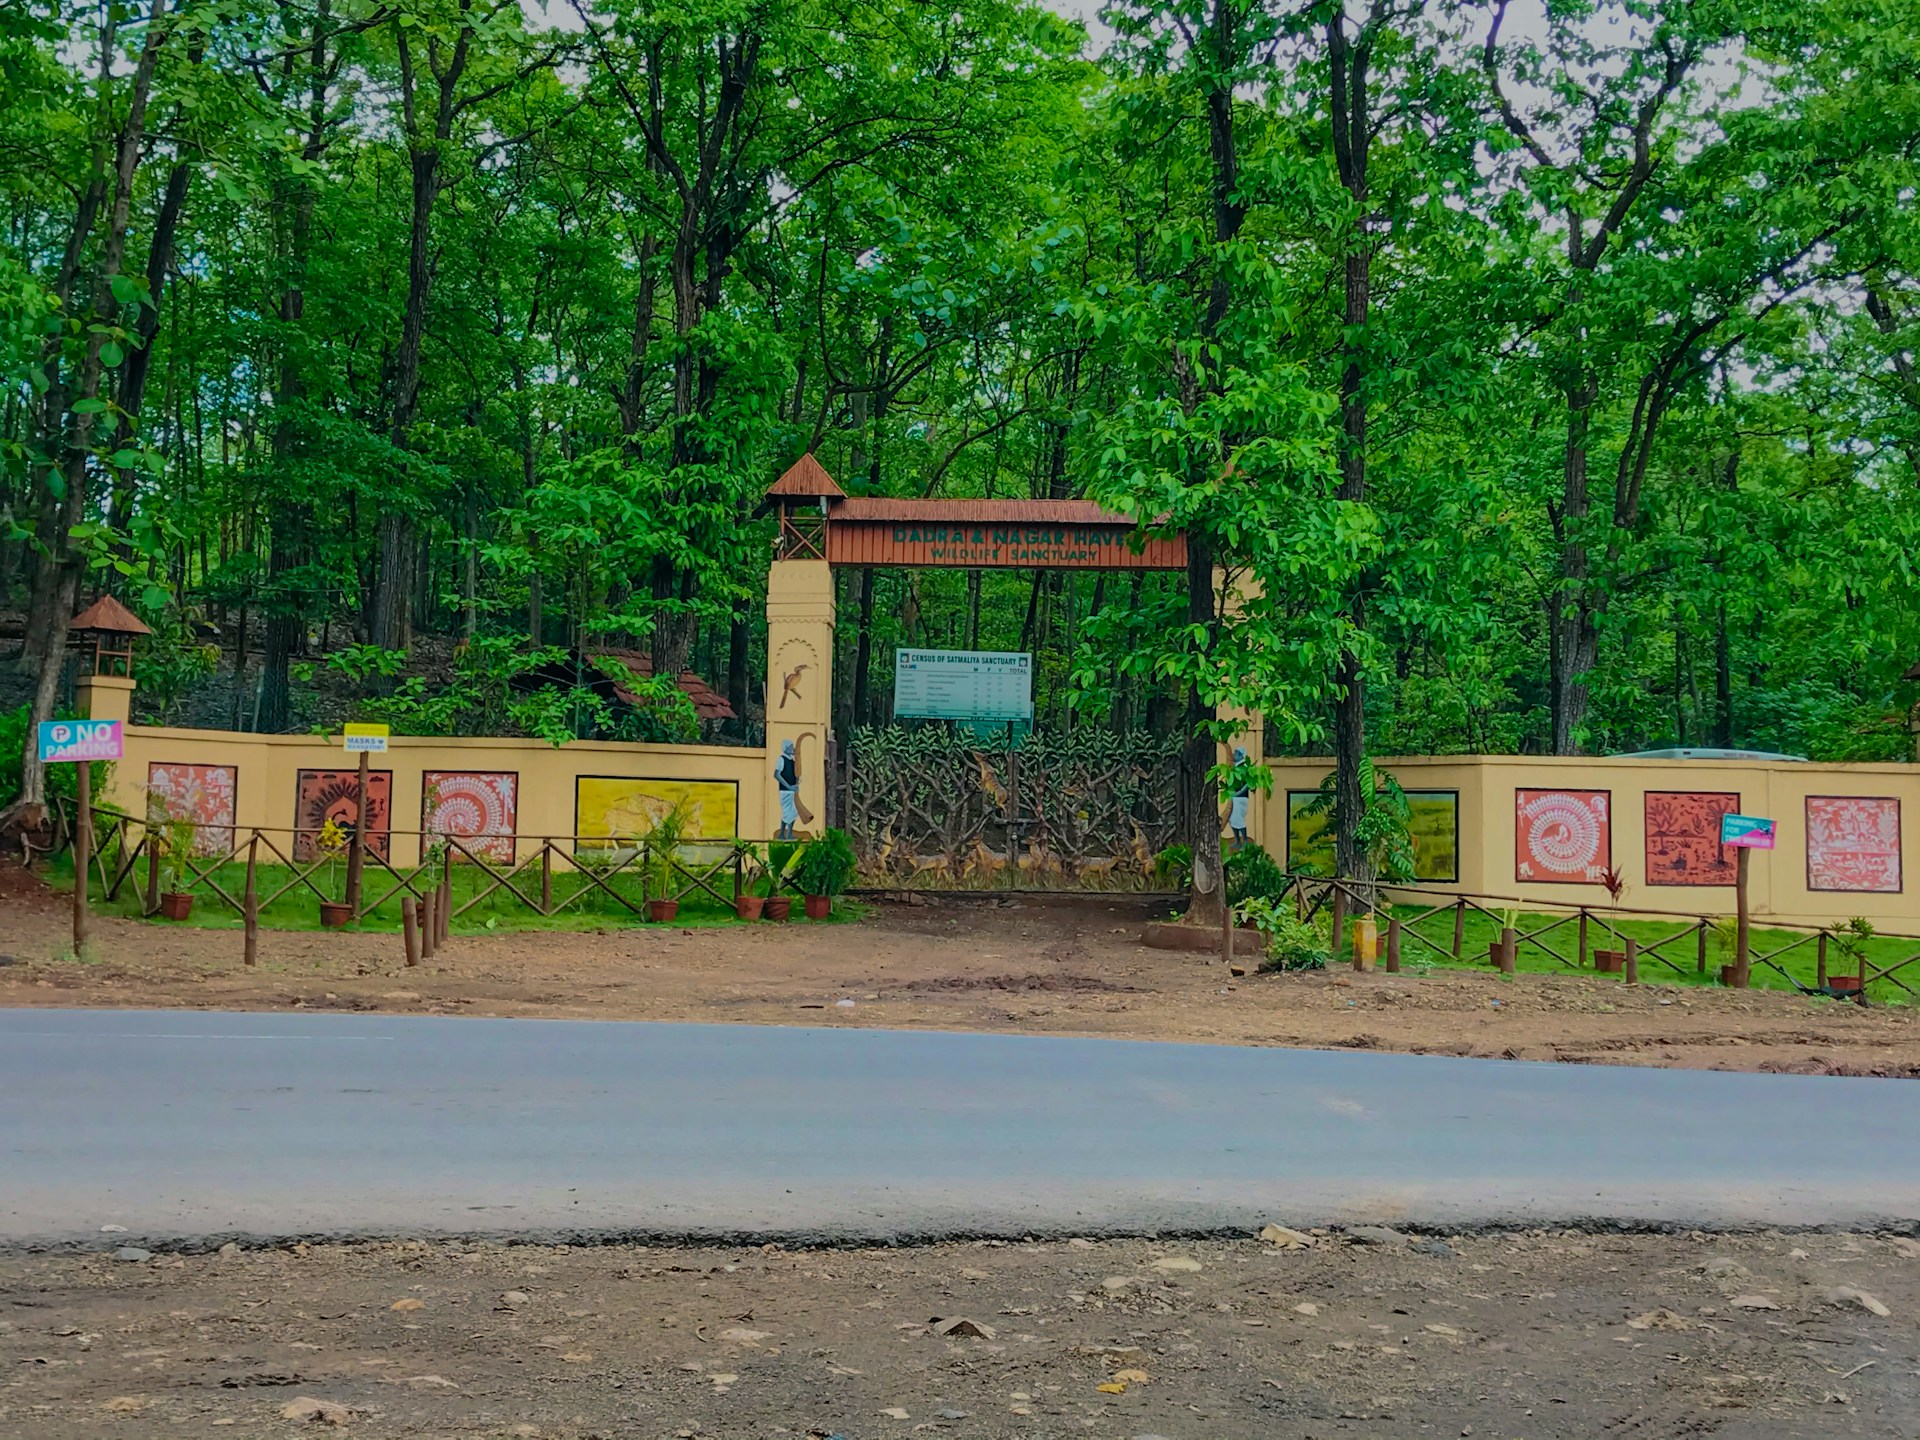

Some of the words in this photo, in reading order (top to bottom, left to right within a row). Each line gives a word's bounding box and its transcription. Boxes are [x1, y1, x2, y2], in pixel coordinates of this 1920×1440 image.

[894, 528, 964, 544] DADRA
[971, 529, 984, 544] &
[993, 529, 1065, 545] NAGAR
[1074, 530, 1128, 546] HAVE
[931, 547, 999, 560] WILDLIFE
[1011, 549, 1098, 561] SANCTUARY
[911, 654, 936, 663] CENSUS
[937, 655, 945, 663] OF
[947, 655, 980, 665] SATMALIYA
[981, 656, 1017, 666] SANCTUARY
[76, 722, 112, 742] NO
[347, 737, 376, 745] MASKS
[45, 742, 118, 758] PARKING
